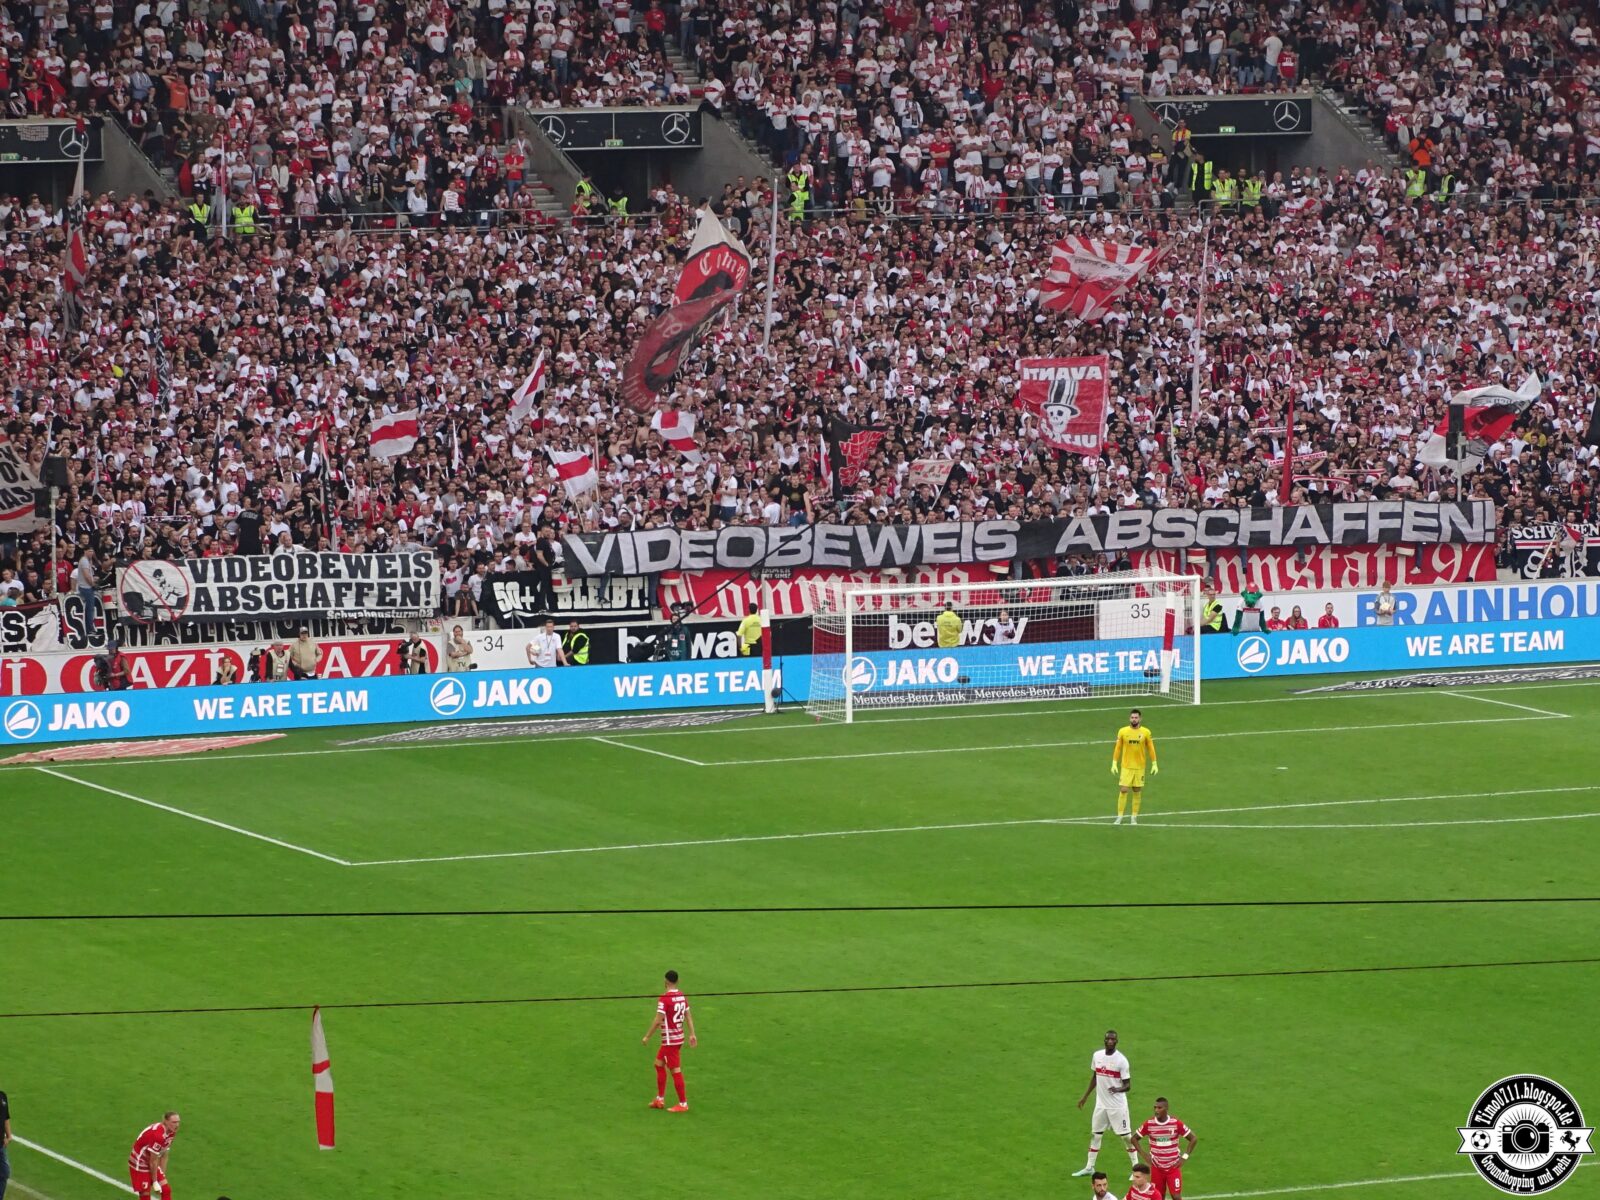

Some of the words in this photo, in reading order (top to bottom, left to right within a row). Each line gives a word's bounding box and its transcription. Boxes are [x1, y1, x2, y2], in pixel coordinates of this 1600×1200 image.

[564, 522, 1021, 574] VIDEOBEWEIS
[1055, 501, 1494, 553] ABSCHAFFEN!
[190, 551, 433, 584] VIDEOBEWEIS
[1431, 543, 1487, 584] 97
[193, 580, 433, 613] ABSCHAFFEN!
[493, 580, 549, 613] 50+
[1131, 603, 1151, 618] 35
[1276, 637, 1350, 666] JAKO
[1406, 635, 1443, 657] WE
[1448, 633, 1495, 655] ARE
[1500, 630, 1564, 653] TEAM
[883, 656, 959, 687] JAKO
[1018, 654, 1056, 677] WE
[1061, 651, 1110, 675] ARE
[1115, 648, 1181, 673] TEAM
[473, 677, 552, 708] JAKO
[614, 675, 653, 698] WE
[659, 672, 709, 696] ARE
[715, 668, 782, 692] TEAM
[853, 692, 934, 707] Mercedes-Benz
[938, 690, 966, 702] Bank
[974, 686, 1056, 700] Mercedes-Benz
[1059, 684, 1088, 696] Bank
[48, 700, 130, 731] JAKO
[193, 696, 234, 721] WE
[241, 694, 292, 718] ARE
[297, 690, 368, 715] TEAM
[673, 1002, 686, 1023] 23
